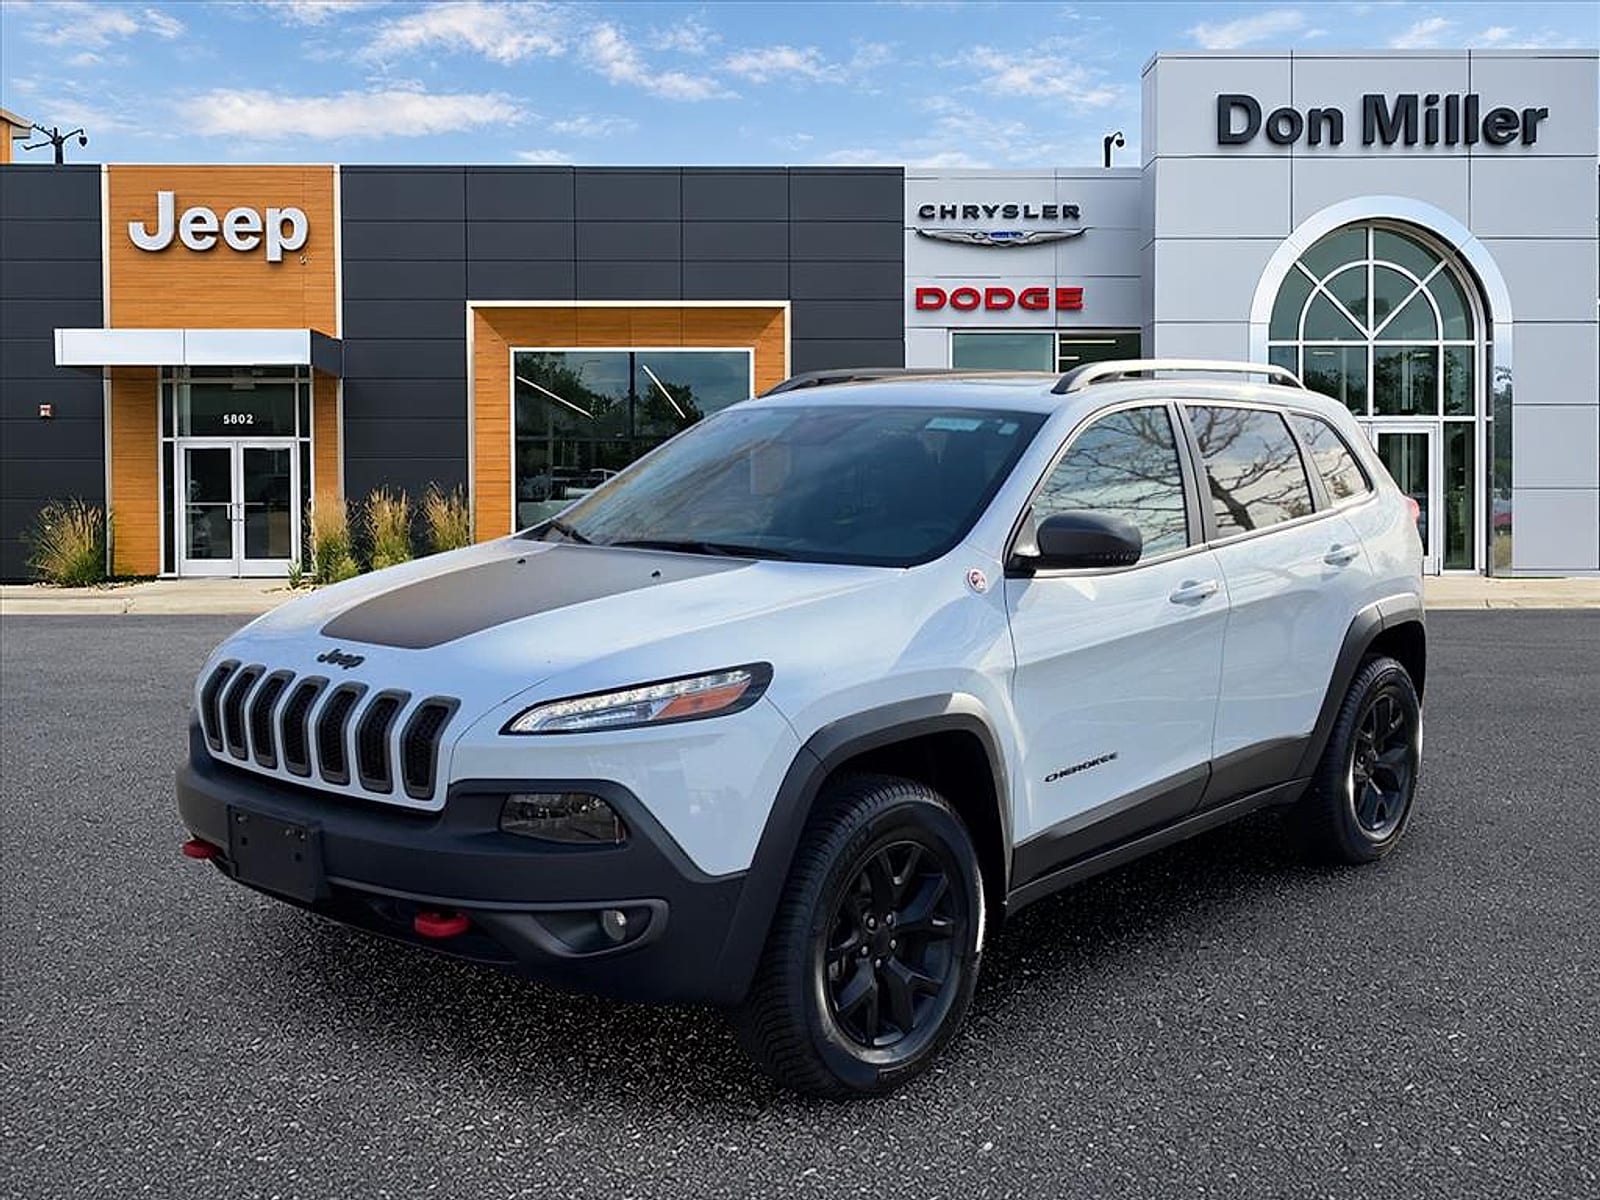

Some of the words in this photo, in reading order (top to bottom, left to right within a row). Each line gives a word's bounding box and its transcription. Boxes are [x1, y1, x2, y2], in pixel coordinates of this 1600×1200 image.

[1217, 93, 1345, 146] Don
[1362, 93, 1549, 146] Miller
[918, 203, 1081, 220] CHRYSLER
[128, 190, 309, 263] Jeep
[915, 287, 1084, 311] DODGE
[223, 413, 254, 425] 5802
[317, 648, 365, 670] Jeep
[1044, 752, 1118, 782] CHEROKEE
